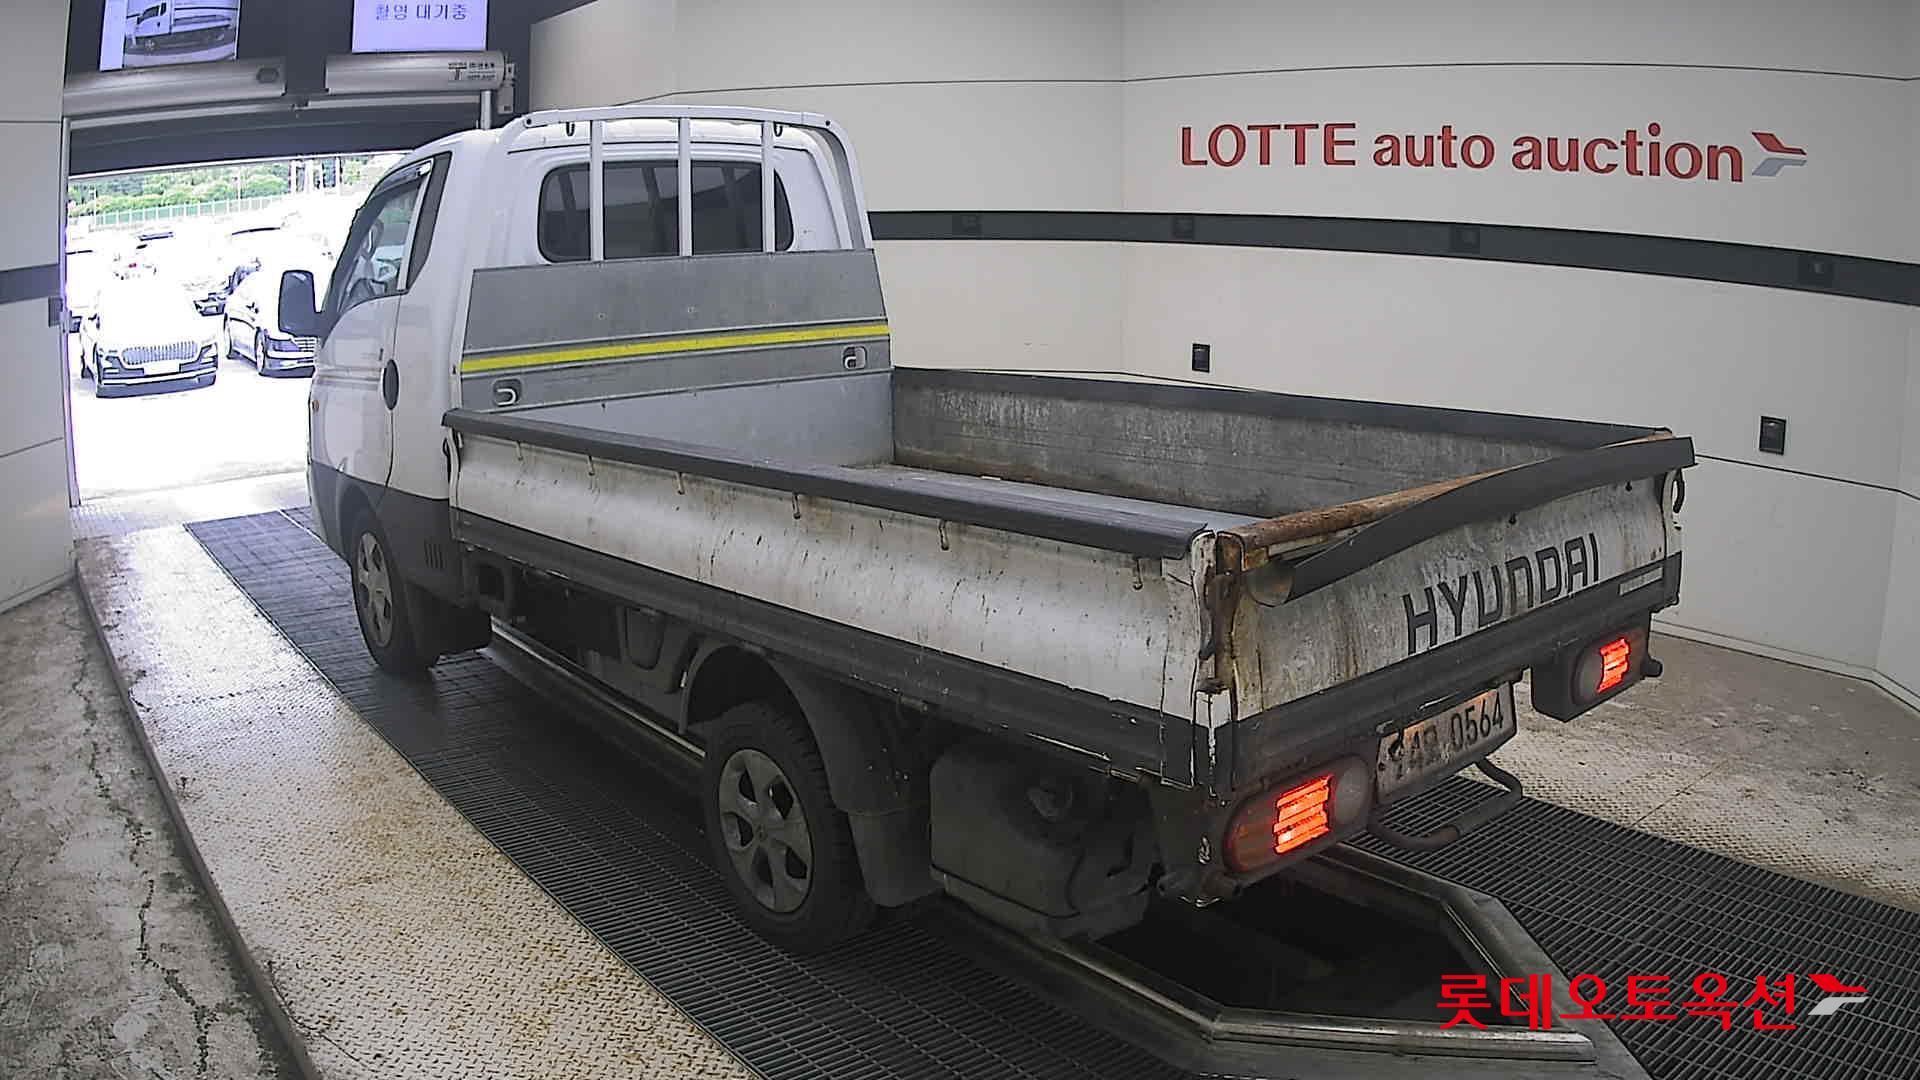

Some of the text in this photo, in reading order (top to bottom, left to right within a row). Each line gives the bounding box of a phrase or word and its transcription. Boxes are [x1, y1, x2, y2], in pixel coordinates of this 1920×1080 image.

[415, 3, 467, 21] 대기중
[1180, 122, 1744, 183] LOTTE auto auction
[1402, 532, 1600, 655] HYUNDAI
[1449, 691, 1504, 753] 0564
